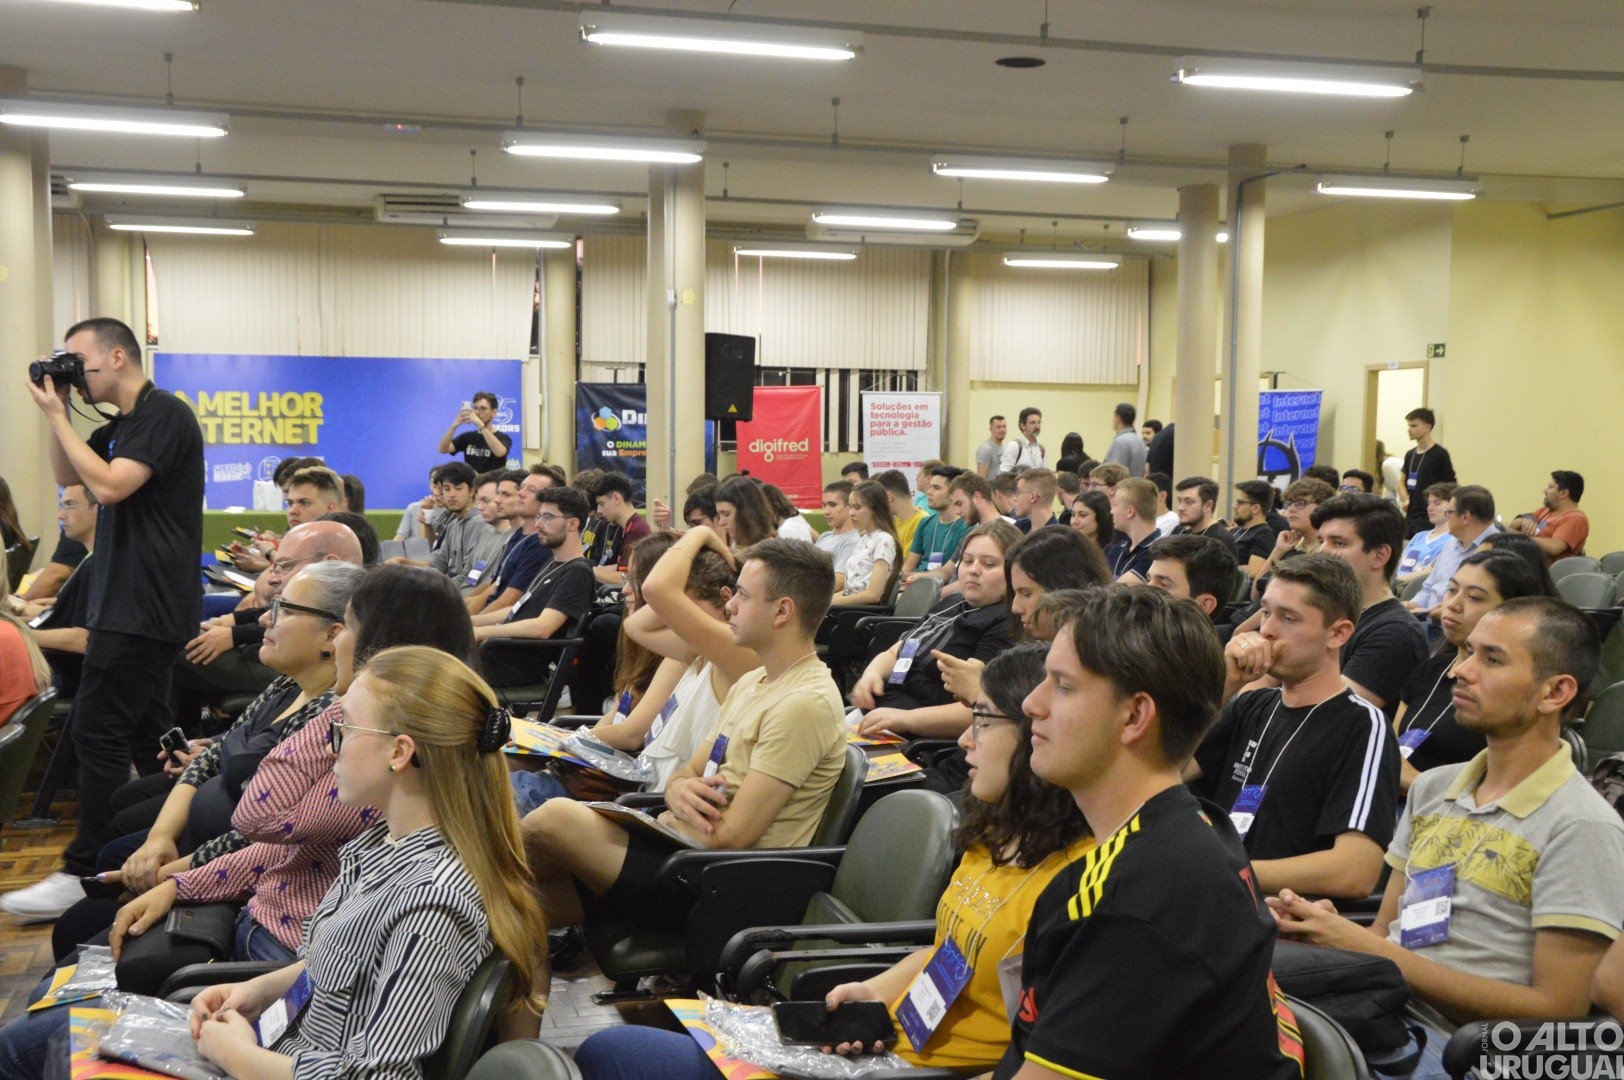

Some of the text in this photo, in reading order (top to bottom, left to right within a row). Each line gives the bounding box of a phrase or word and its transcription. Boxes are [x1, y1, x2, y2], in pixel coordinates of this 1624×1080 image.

[198, 391, 324, 418] MELHOR
[870, 402, 928, 411] Soluções em
[1273, 394, 1320, 408] Internet
[870, 411, 920, 420] tecnologia
[1272, 407, 1319, 422] Internet
[870, 420, 891, 428] para
[901, 419, 932, 429] gestão
[200, 417, 324, 444] TERNET
[870, 428, 907, 437] pública.
[606, 440, 615, 449] O
[749, 438, 809, 462] digifred
